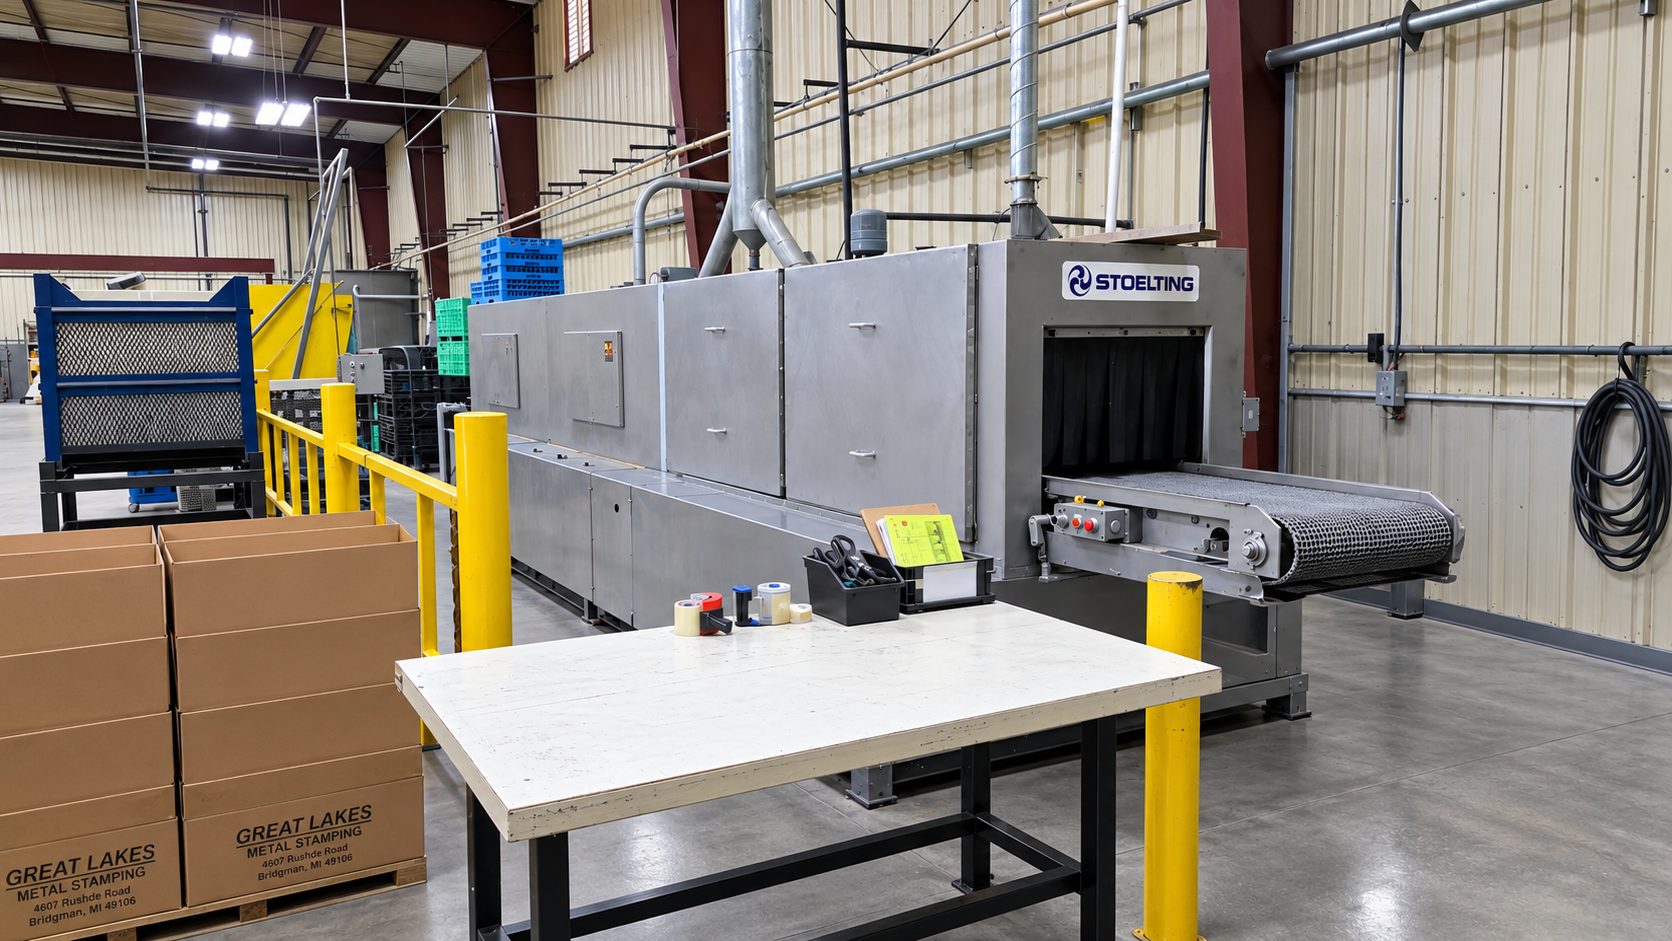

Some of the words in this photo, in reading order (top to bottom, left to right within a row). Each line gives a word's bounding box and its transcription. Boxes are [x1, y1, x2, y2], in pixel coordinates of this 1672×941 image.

[1095, 274, 1194, 292] STOELTING
[236, 817, 305, 845] GREAT
[309, 804, 372, 831] LAKES
[247, 841, 292, 859] METAL
[296, 826, 362, 849] STAMPING
[262, 856, 284, 868] 4607
[324, 843, 348, 856] Road
[6, 857, 81, 887] GREAT
[87, 844, 155, 871] LAKES
[257, 864, 308, 881] Bridgman,
[310, 860, 322, 870] MI
[17, 883, 67, 902] METAL
[71, 866, 146, 891] STAMPING
[34, 900, 58, 912] 4607
[62, 892, 101, 907] Rushde
[104, 885, 131, 898] Road
[29, 909, 86, 927] Bridgman,
[89, 903, 102, 914] MI
[105, 896, 136, 910] 49106
